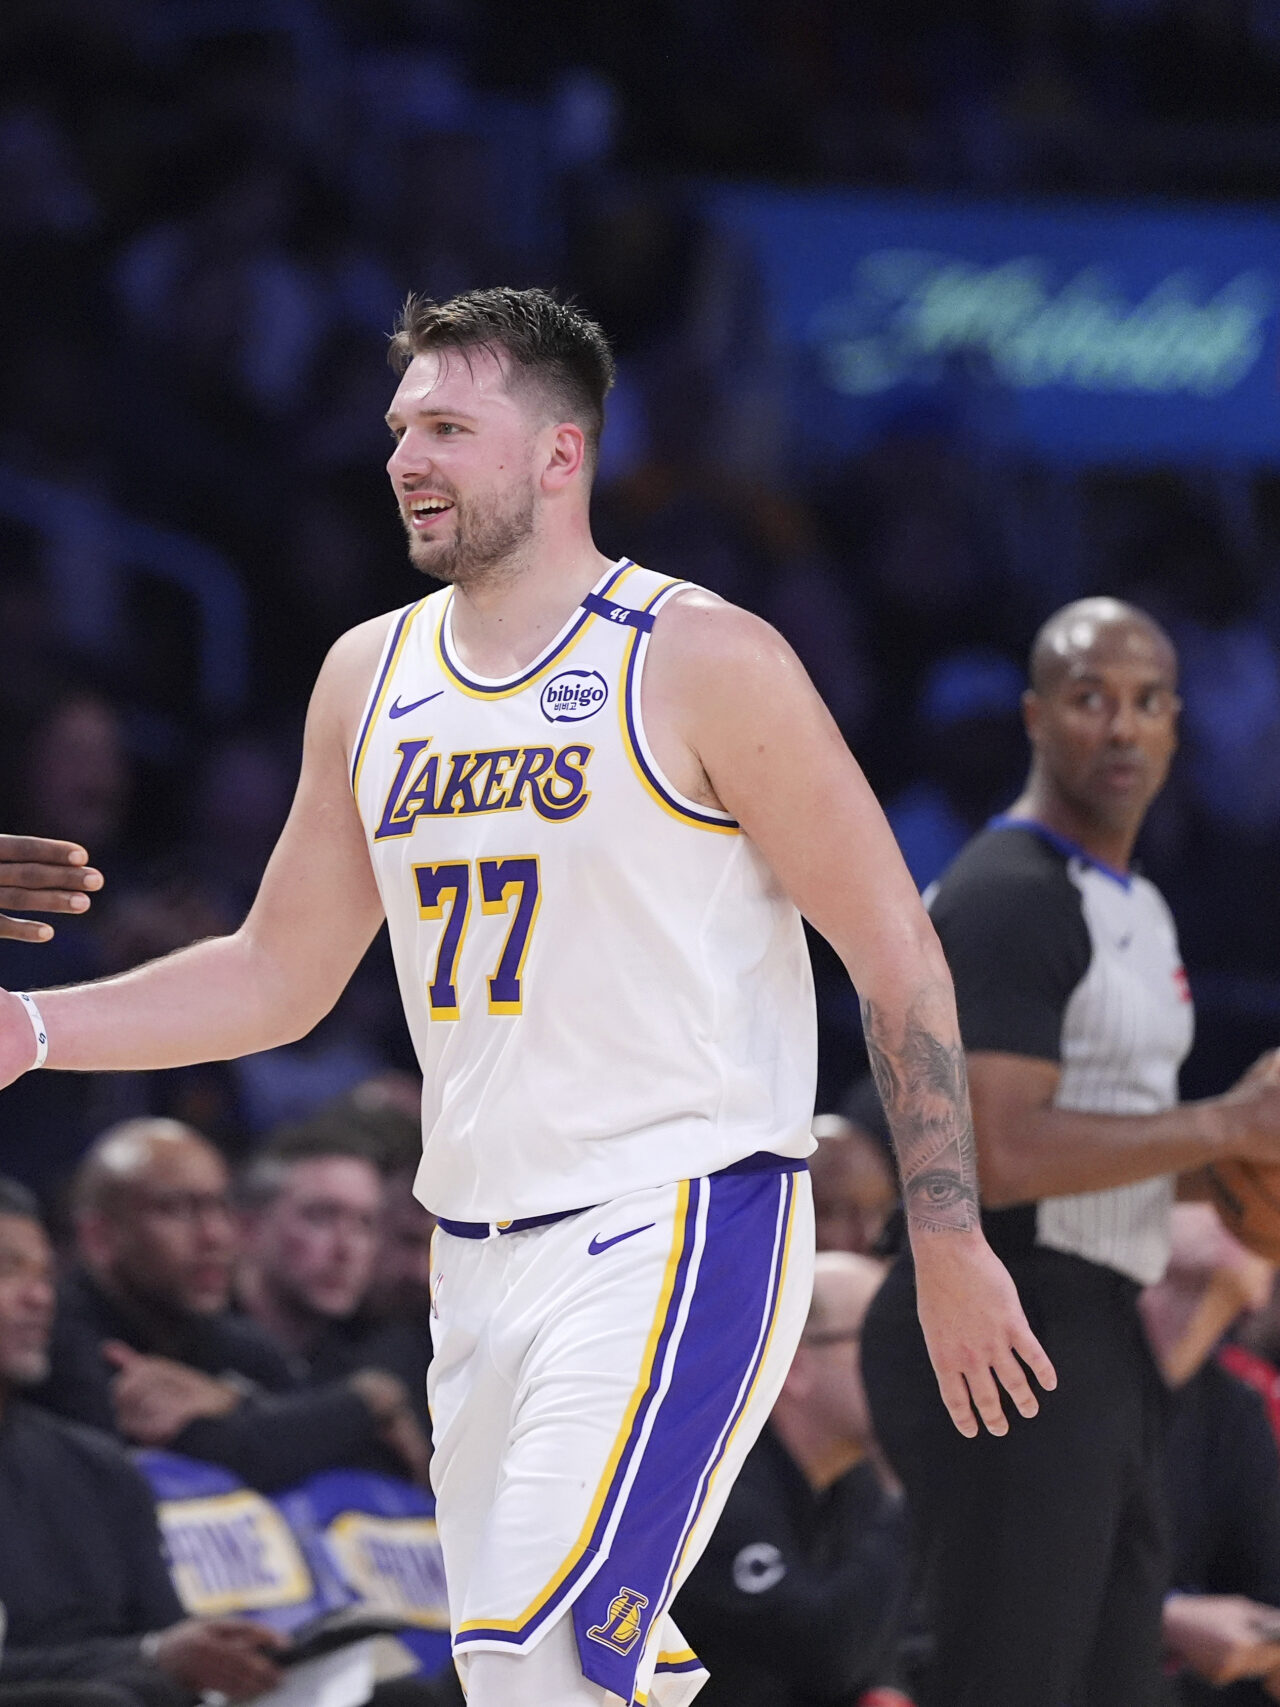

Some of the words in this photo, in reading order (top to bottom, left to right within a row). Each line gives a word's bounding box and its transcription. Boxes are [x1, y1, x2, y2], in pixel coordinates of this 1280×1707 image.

[610, 607, 631, 623] 44
[546, 683, 604, 706] bibigo
[553, 702, 577, 711] 비비고
[373, 735, 595, 843] LAKERS
[410, 853, 542, 1022] 77
